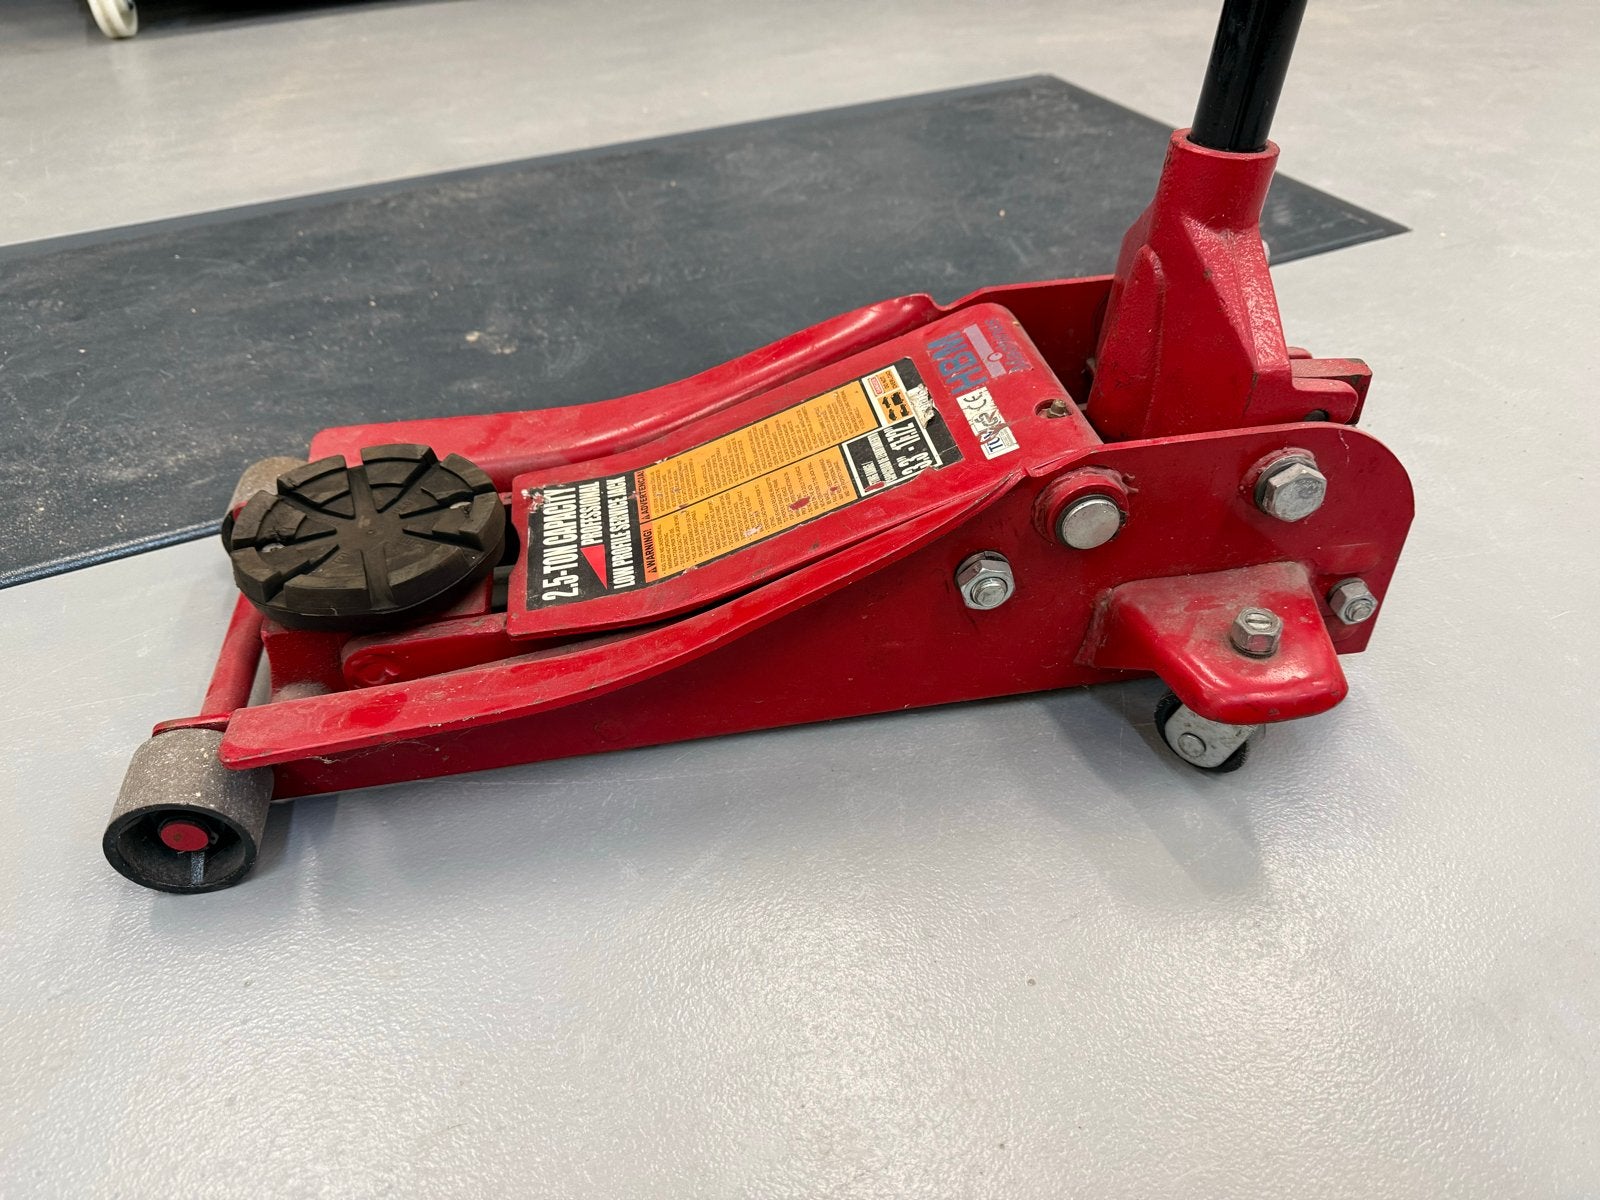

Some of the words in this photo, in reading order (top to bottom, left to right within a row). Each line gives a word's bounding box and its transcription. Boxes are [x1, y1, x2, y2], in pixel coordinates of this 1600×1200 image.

[927, 331, 989, 394] HBM
[606, 476, 627, 498] JACK
[637, 470, 650, 514] ADVERTENCIA!
[542, 487, 578, 546] CAPACITY
[579, 481, 603, 546] PROFESSIONAL
[607, 495, 631, 532] SERVICE
[610, 530, 633, 567] PROFILE
[644, 528, 657, 568] WARNING!
[542, 544, 579, 600] 2.5-TON
[612, 565, 636, 589] LOW
